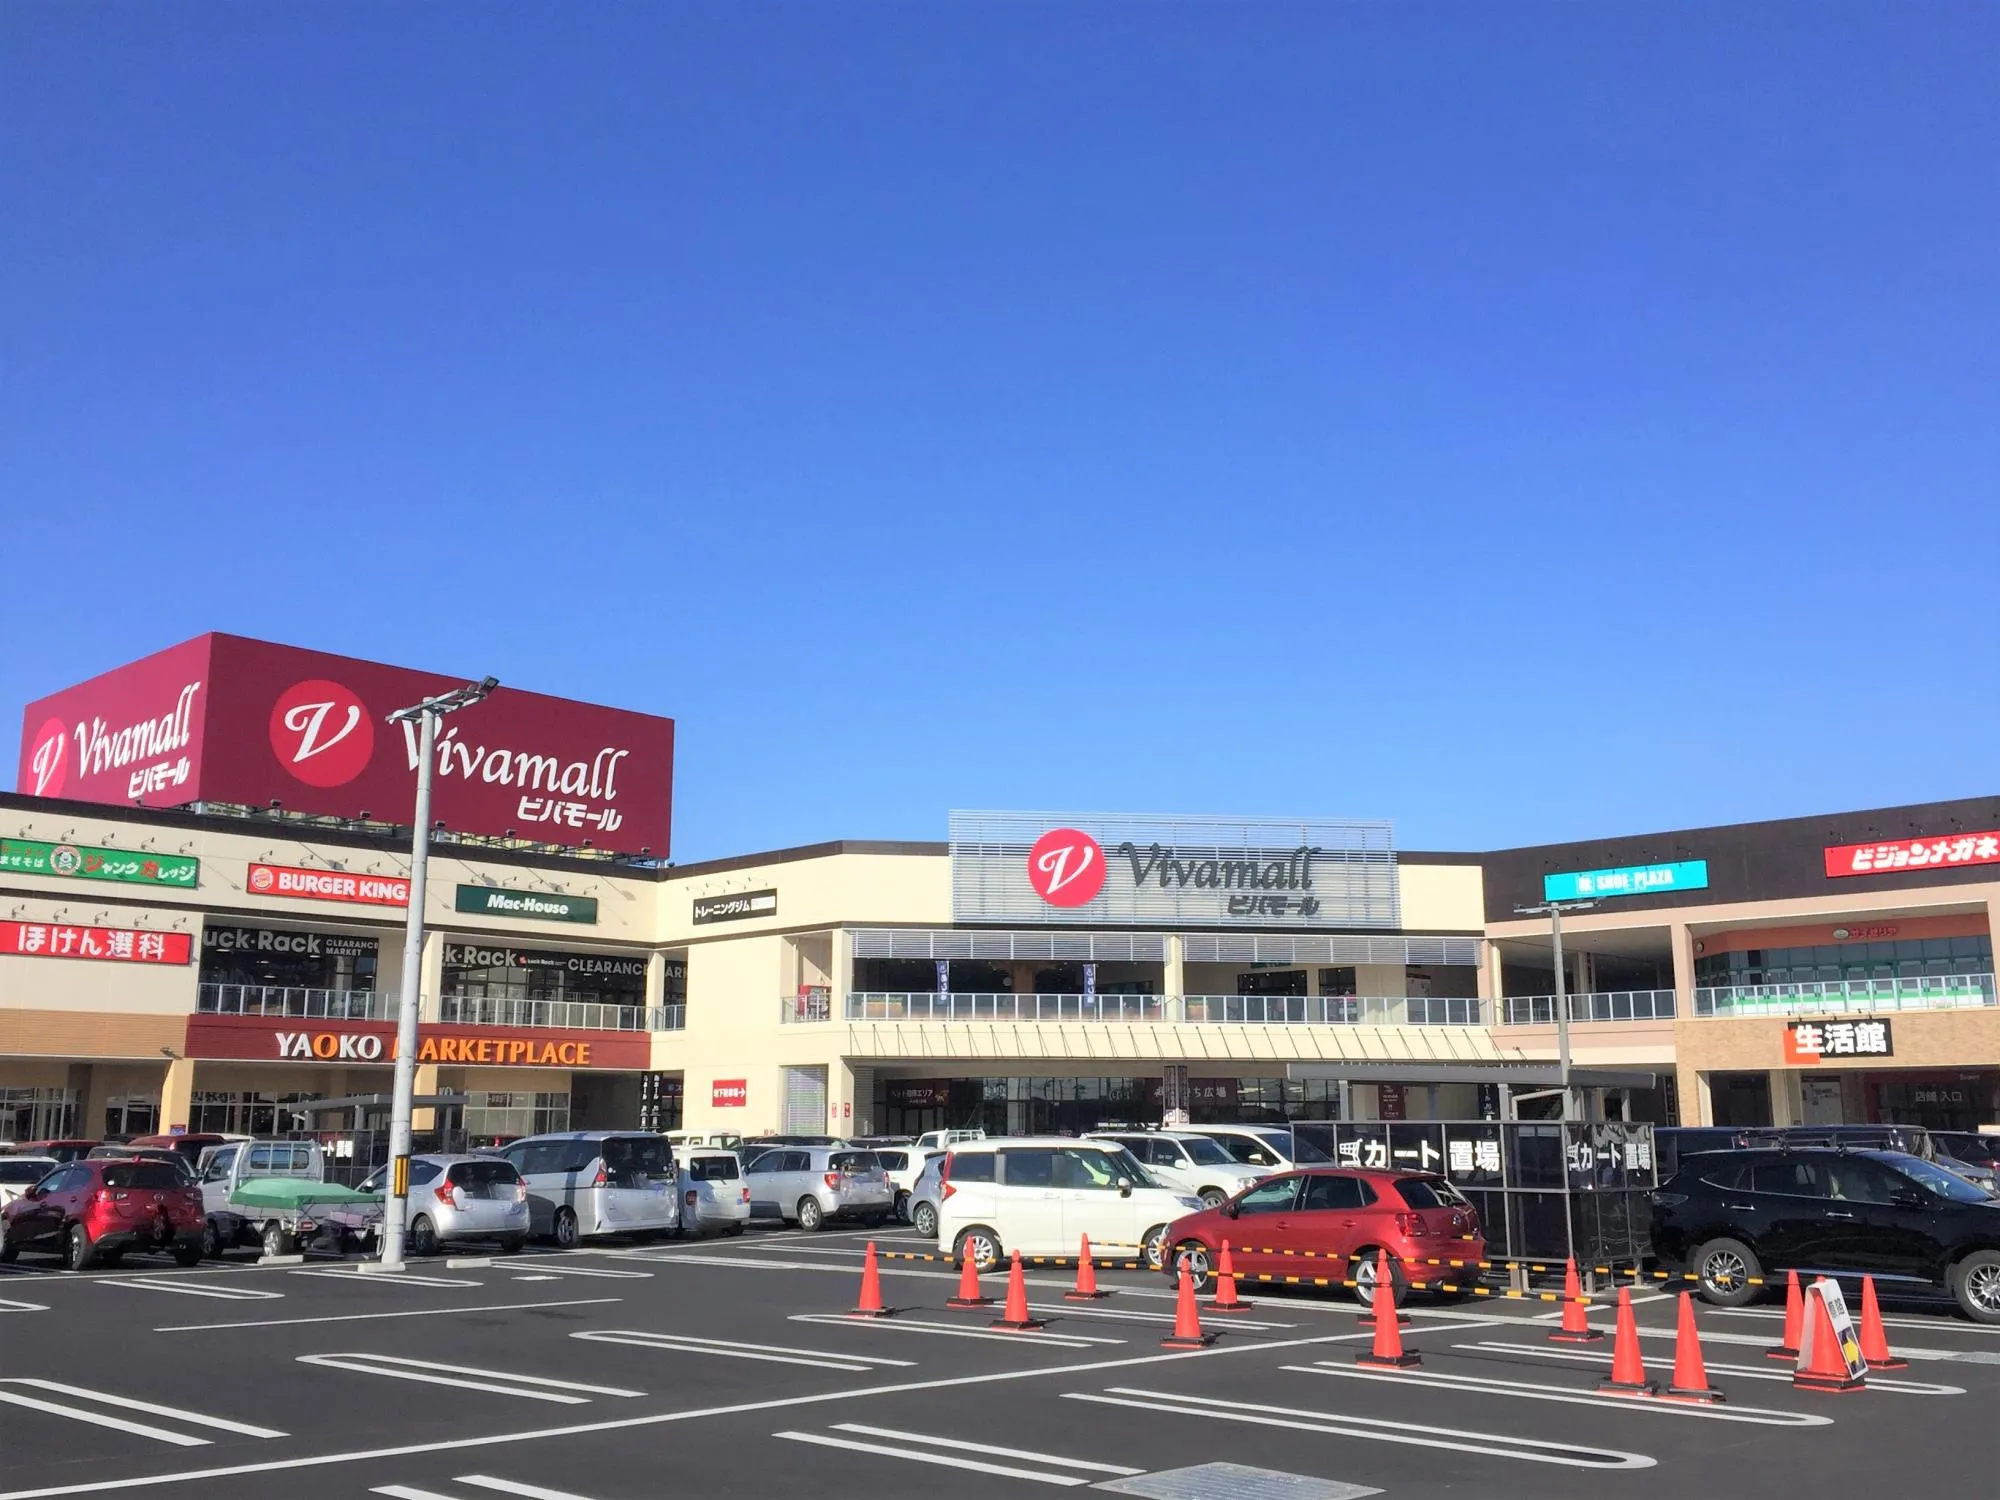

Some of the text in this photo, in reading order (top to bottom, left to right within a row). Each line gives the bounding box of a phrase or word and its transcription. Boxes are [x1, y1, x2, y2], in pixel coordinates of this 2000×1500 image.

[74, 681, 200, 779] Vivamall
[128, 756, 190, 799] ビバモール
[516, 796, 622, 832] ビバモール
[1117, 841, 1321, 891] Vivamall
[1852, 836, 1999, 870] ビジョンメガネ
[278, 872, 356, 896] BURGER
[359, 880, 407, 900] KING
[1633, 869, 1674, 887] PLAZA
[695, 899, 750, 918] トレーニングジム
[1228, 895, 1321, 916] ビバモール
[18, 925, 165, 960] ほけん選科
[274, 1032, 382, 1060] YAOKO
[1795, 1022, 1887, 1054] 生活館
